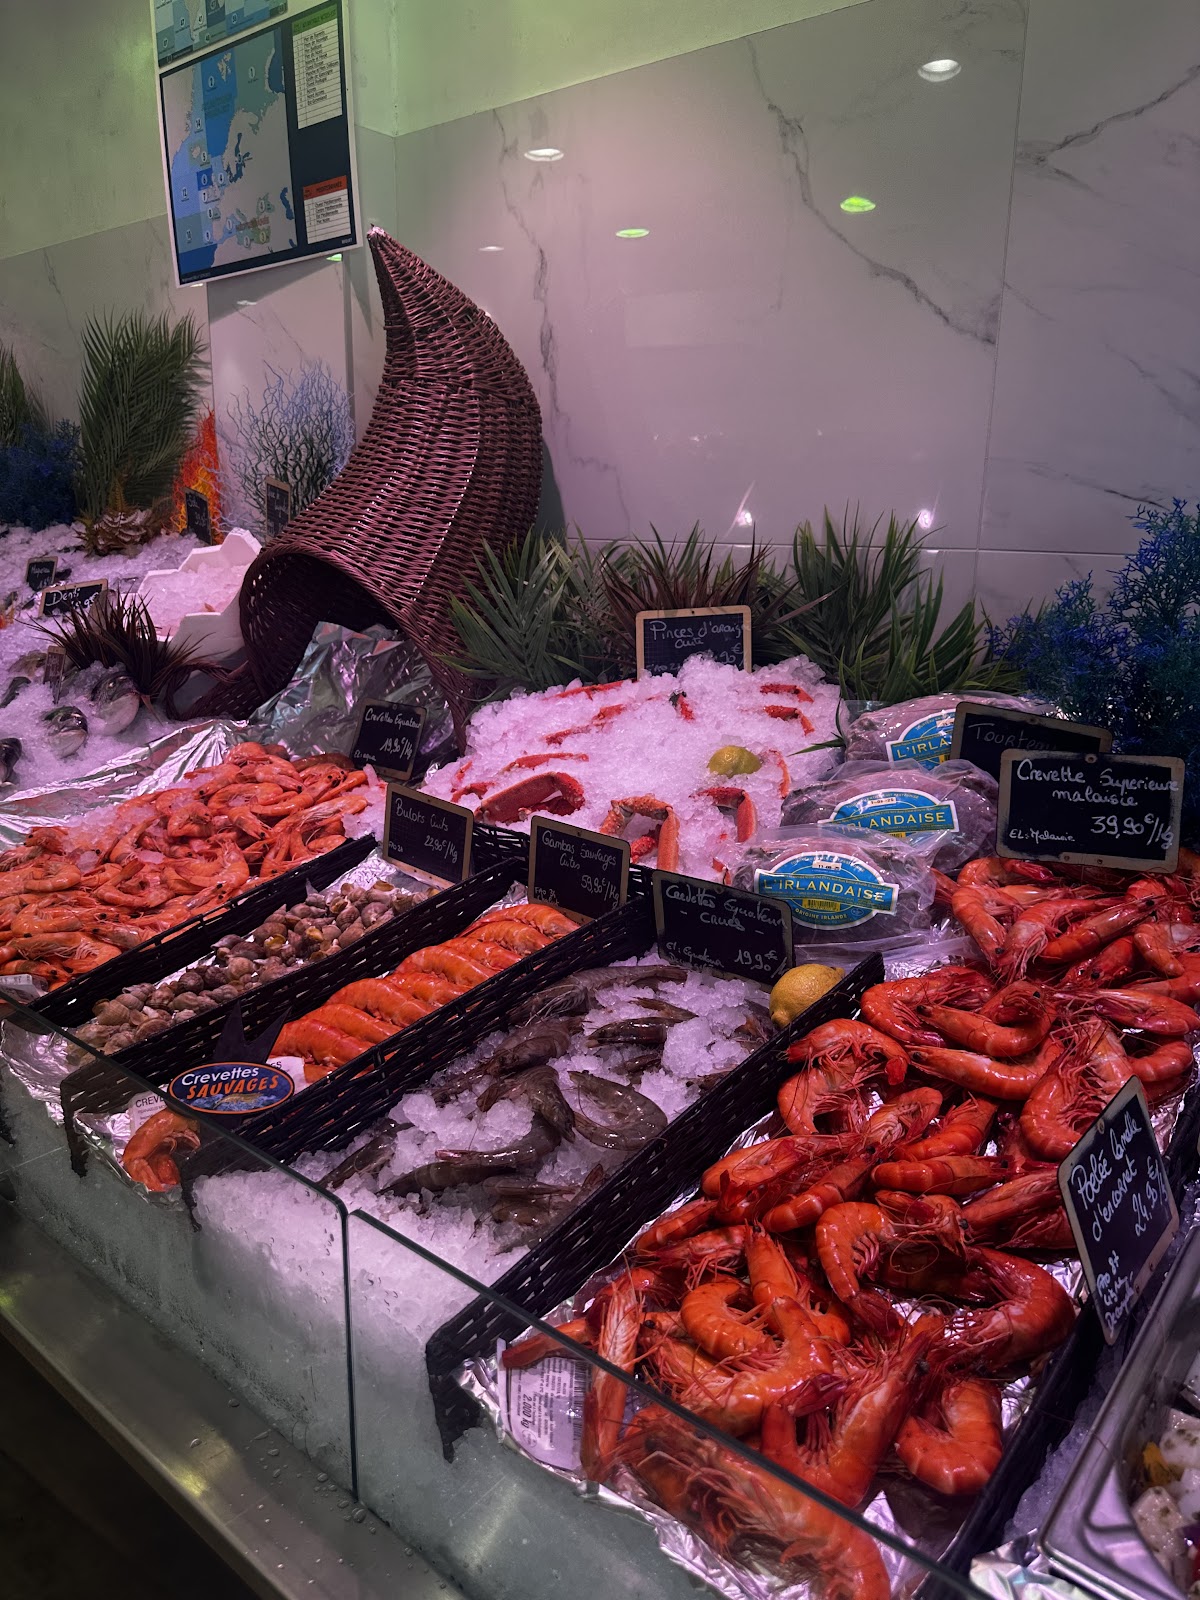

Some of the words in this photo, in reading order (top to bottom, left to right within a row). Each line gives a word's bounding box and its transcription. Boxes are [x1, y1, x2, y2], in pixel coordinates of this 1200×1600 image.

[649, 620, 694, 640] Pinces
[1017, 758, 1086, 784] Crevette
[1099, 768, 1179, 795] Superieure
[396, 798, 425, 824] Bulots
[542, 830, 575, 854] Gambas
[764, 879, 885, 902] L'IRLANDAISE
[181, 1067, 259, 1086] Crevettes
[186, 1075, 279, 1100] SAUVAGES
